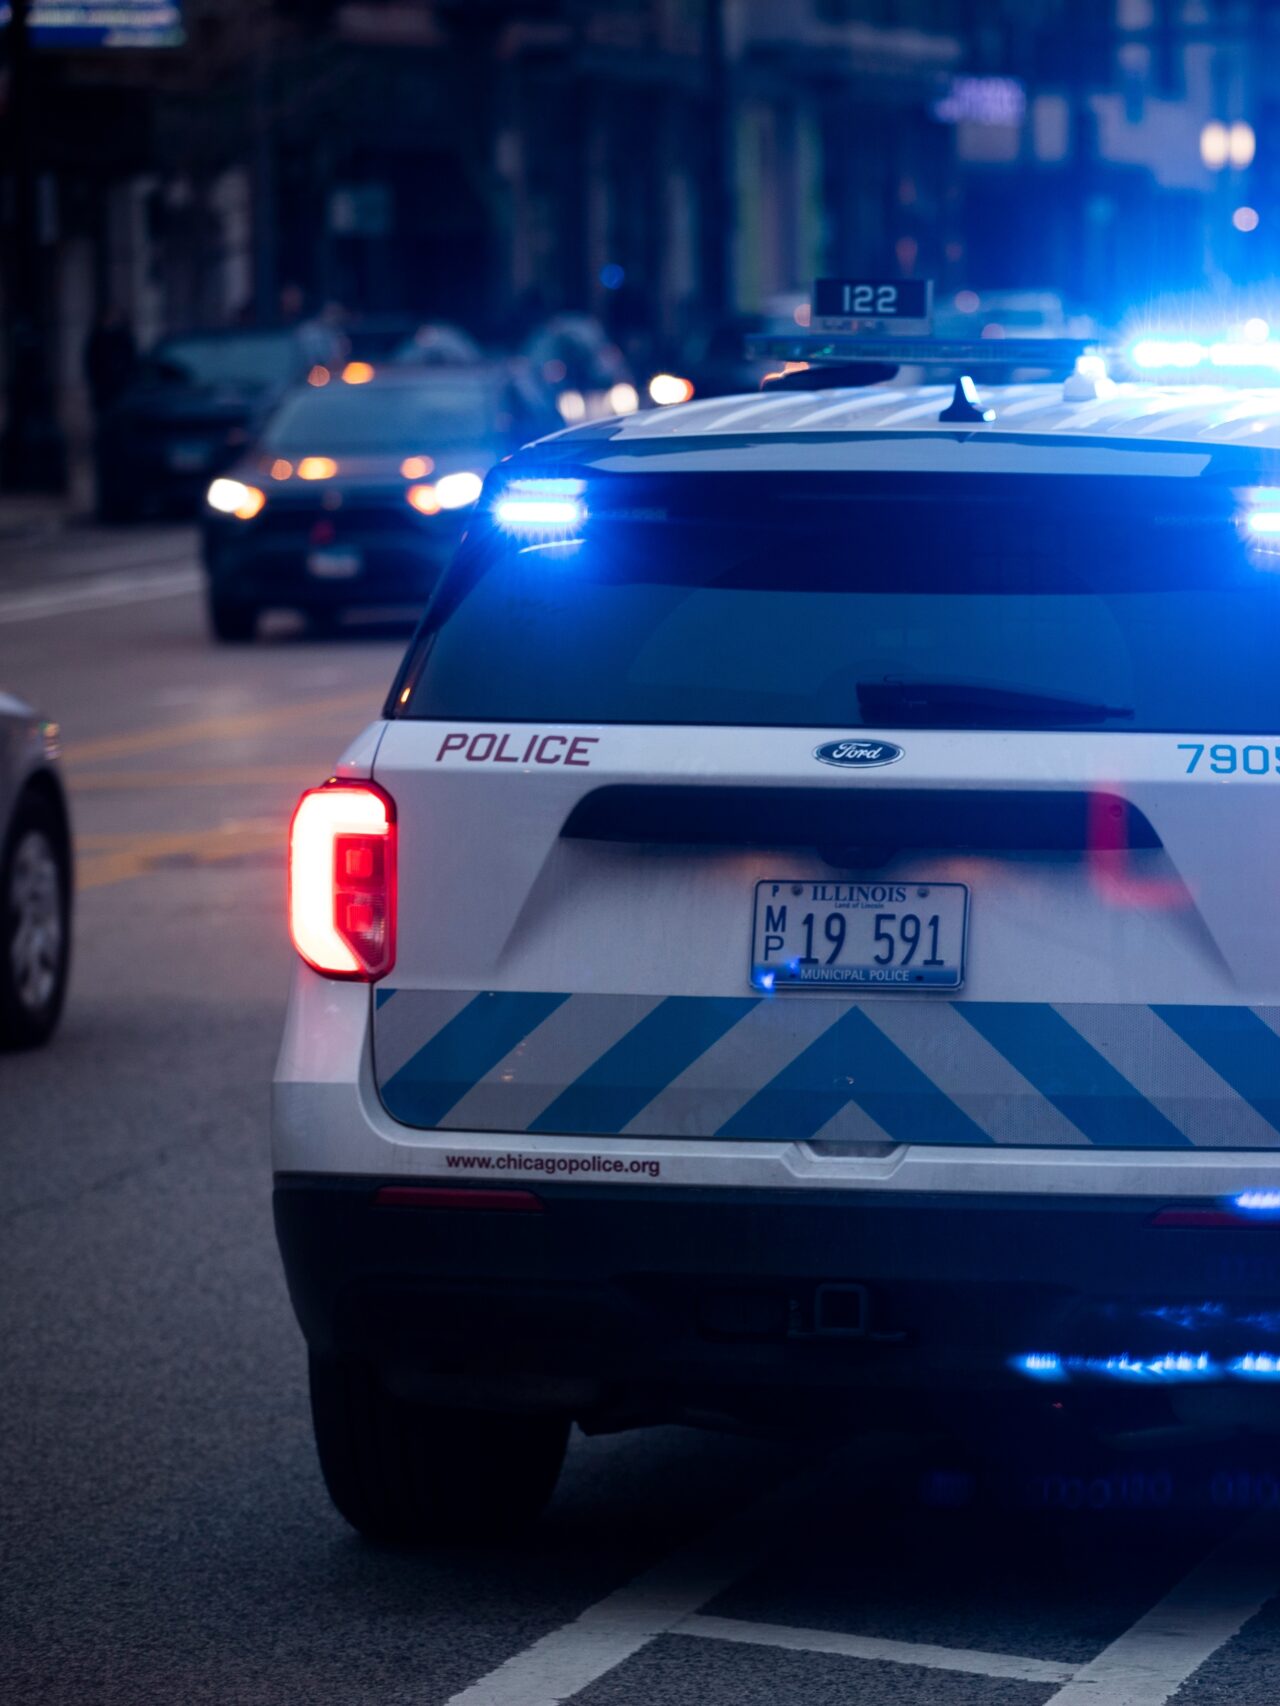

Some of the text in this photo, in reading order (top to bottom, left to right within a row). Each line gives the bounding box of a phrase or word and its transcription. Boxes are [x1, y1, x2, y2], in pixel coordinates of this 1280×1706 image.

[843, 285, 897, 312] 122
[435, 733, 600, 766] POLICE
[832, 742, 883, 759] Ford
[811, 885, 907, 902] ILLINOIS
[797, 912, 945, 965] 19 591
[801, 969, 910, 982] MUNICIPAL POLICE
[446, 1154, 660, 1177] www.chicagopolice.org
